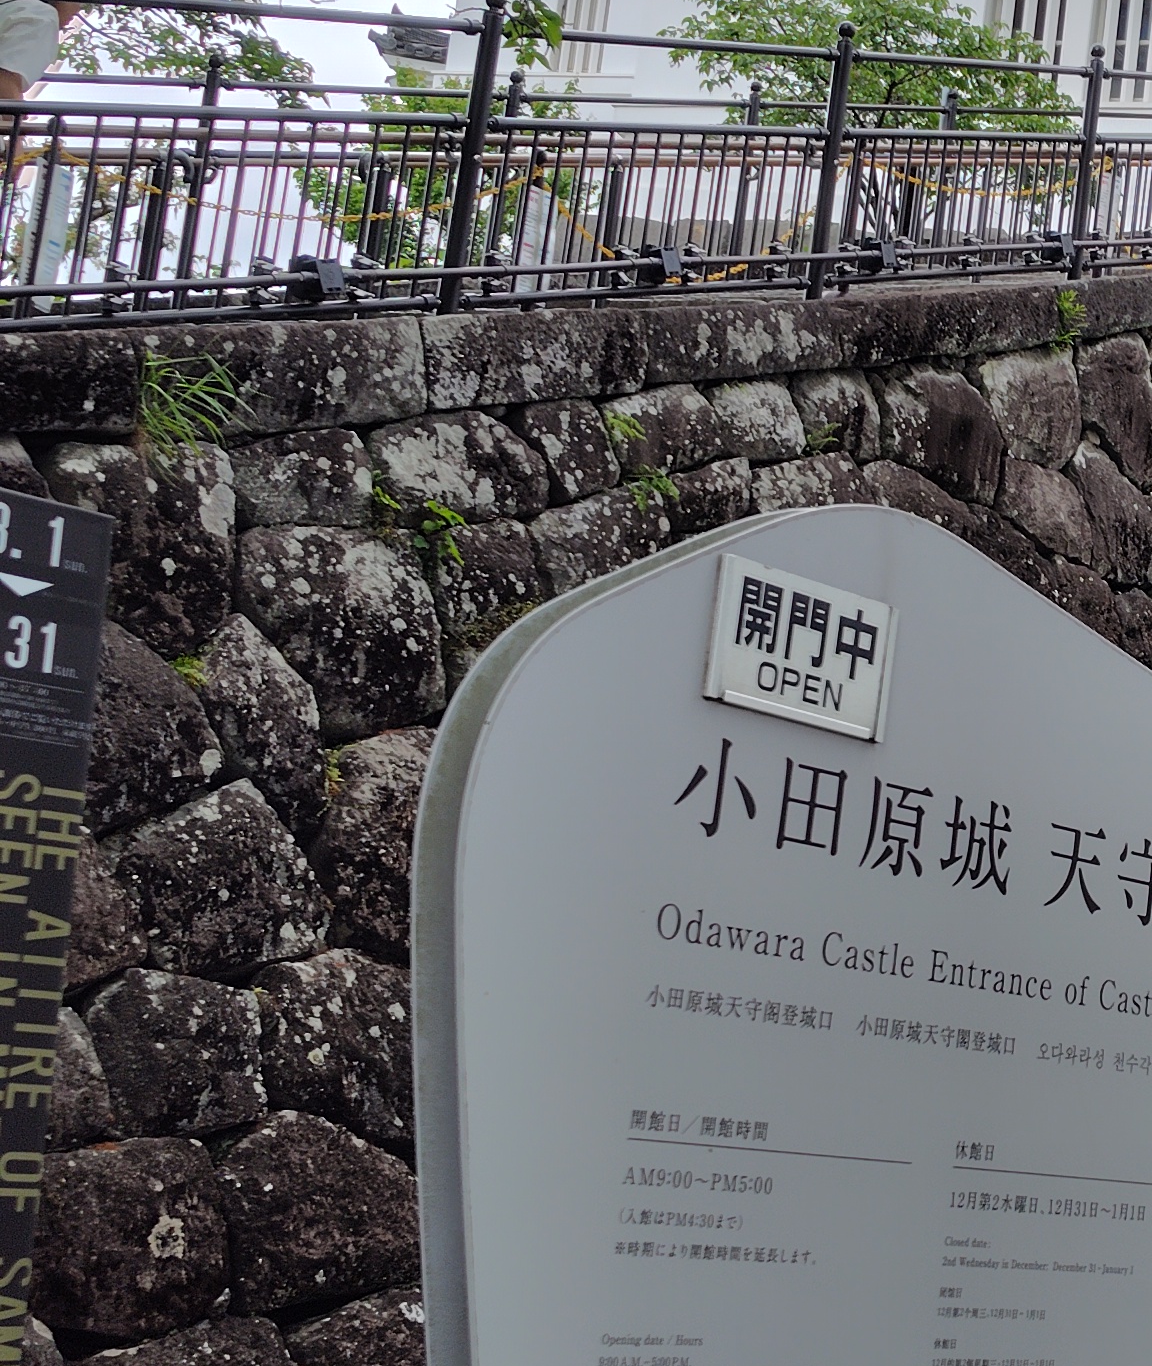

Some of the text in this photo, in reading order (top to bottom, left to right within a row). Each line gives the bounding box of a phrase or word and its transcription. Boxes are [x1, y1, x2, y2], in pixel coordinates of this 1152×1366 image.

[5, 615, 57, 673] 31
[734, 575, 879, 681] 開門中
[757, 660, 843, 711] OPEN
[674, 738, 1012, 895] 小田原城
[657, 904, 804, 961] Odawara
[822, 932, 913, 978] Castle
[928, 950, 1051, 1000] Entrance
[1065, 976, 1089, 1006] of
[1037, 1043, 1104, 1069] 오다와라성
[1114, 1052, 1151, 1075] 천수각
[955, 1140, 995, 1161] 休館日
[944, 1236, 970, 1247] Closed
[942, 1256, 956, 1267] 2nd
[960, 1257, 1000, 1269] Wednesday
[1002, 1261, 1009, 1269] in
[1053, 1261, 1087, 1272] December
[602, 1334, 642, 1347] Opening
[644, 1335, 664, 1345] date
[675, 1335, 703, 1346] Hours
